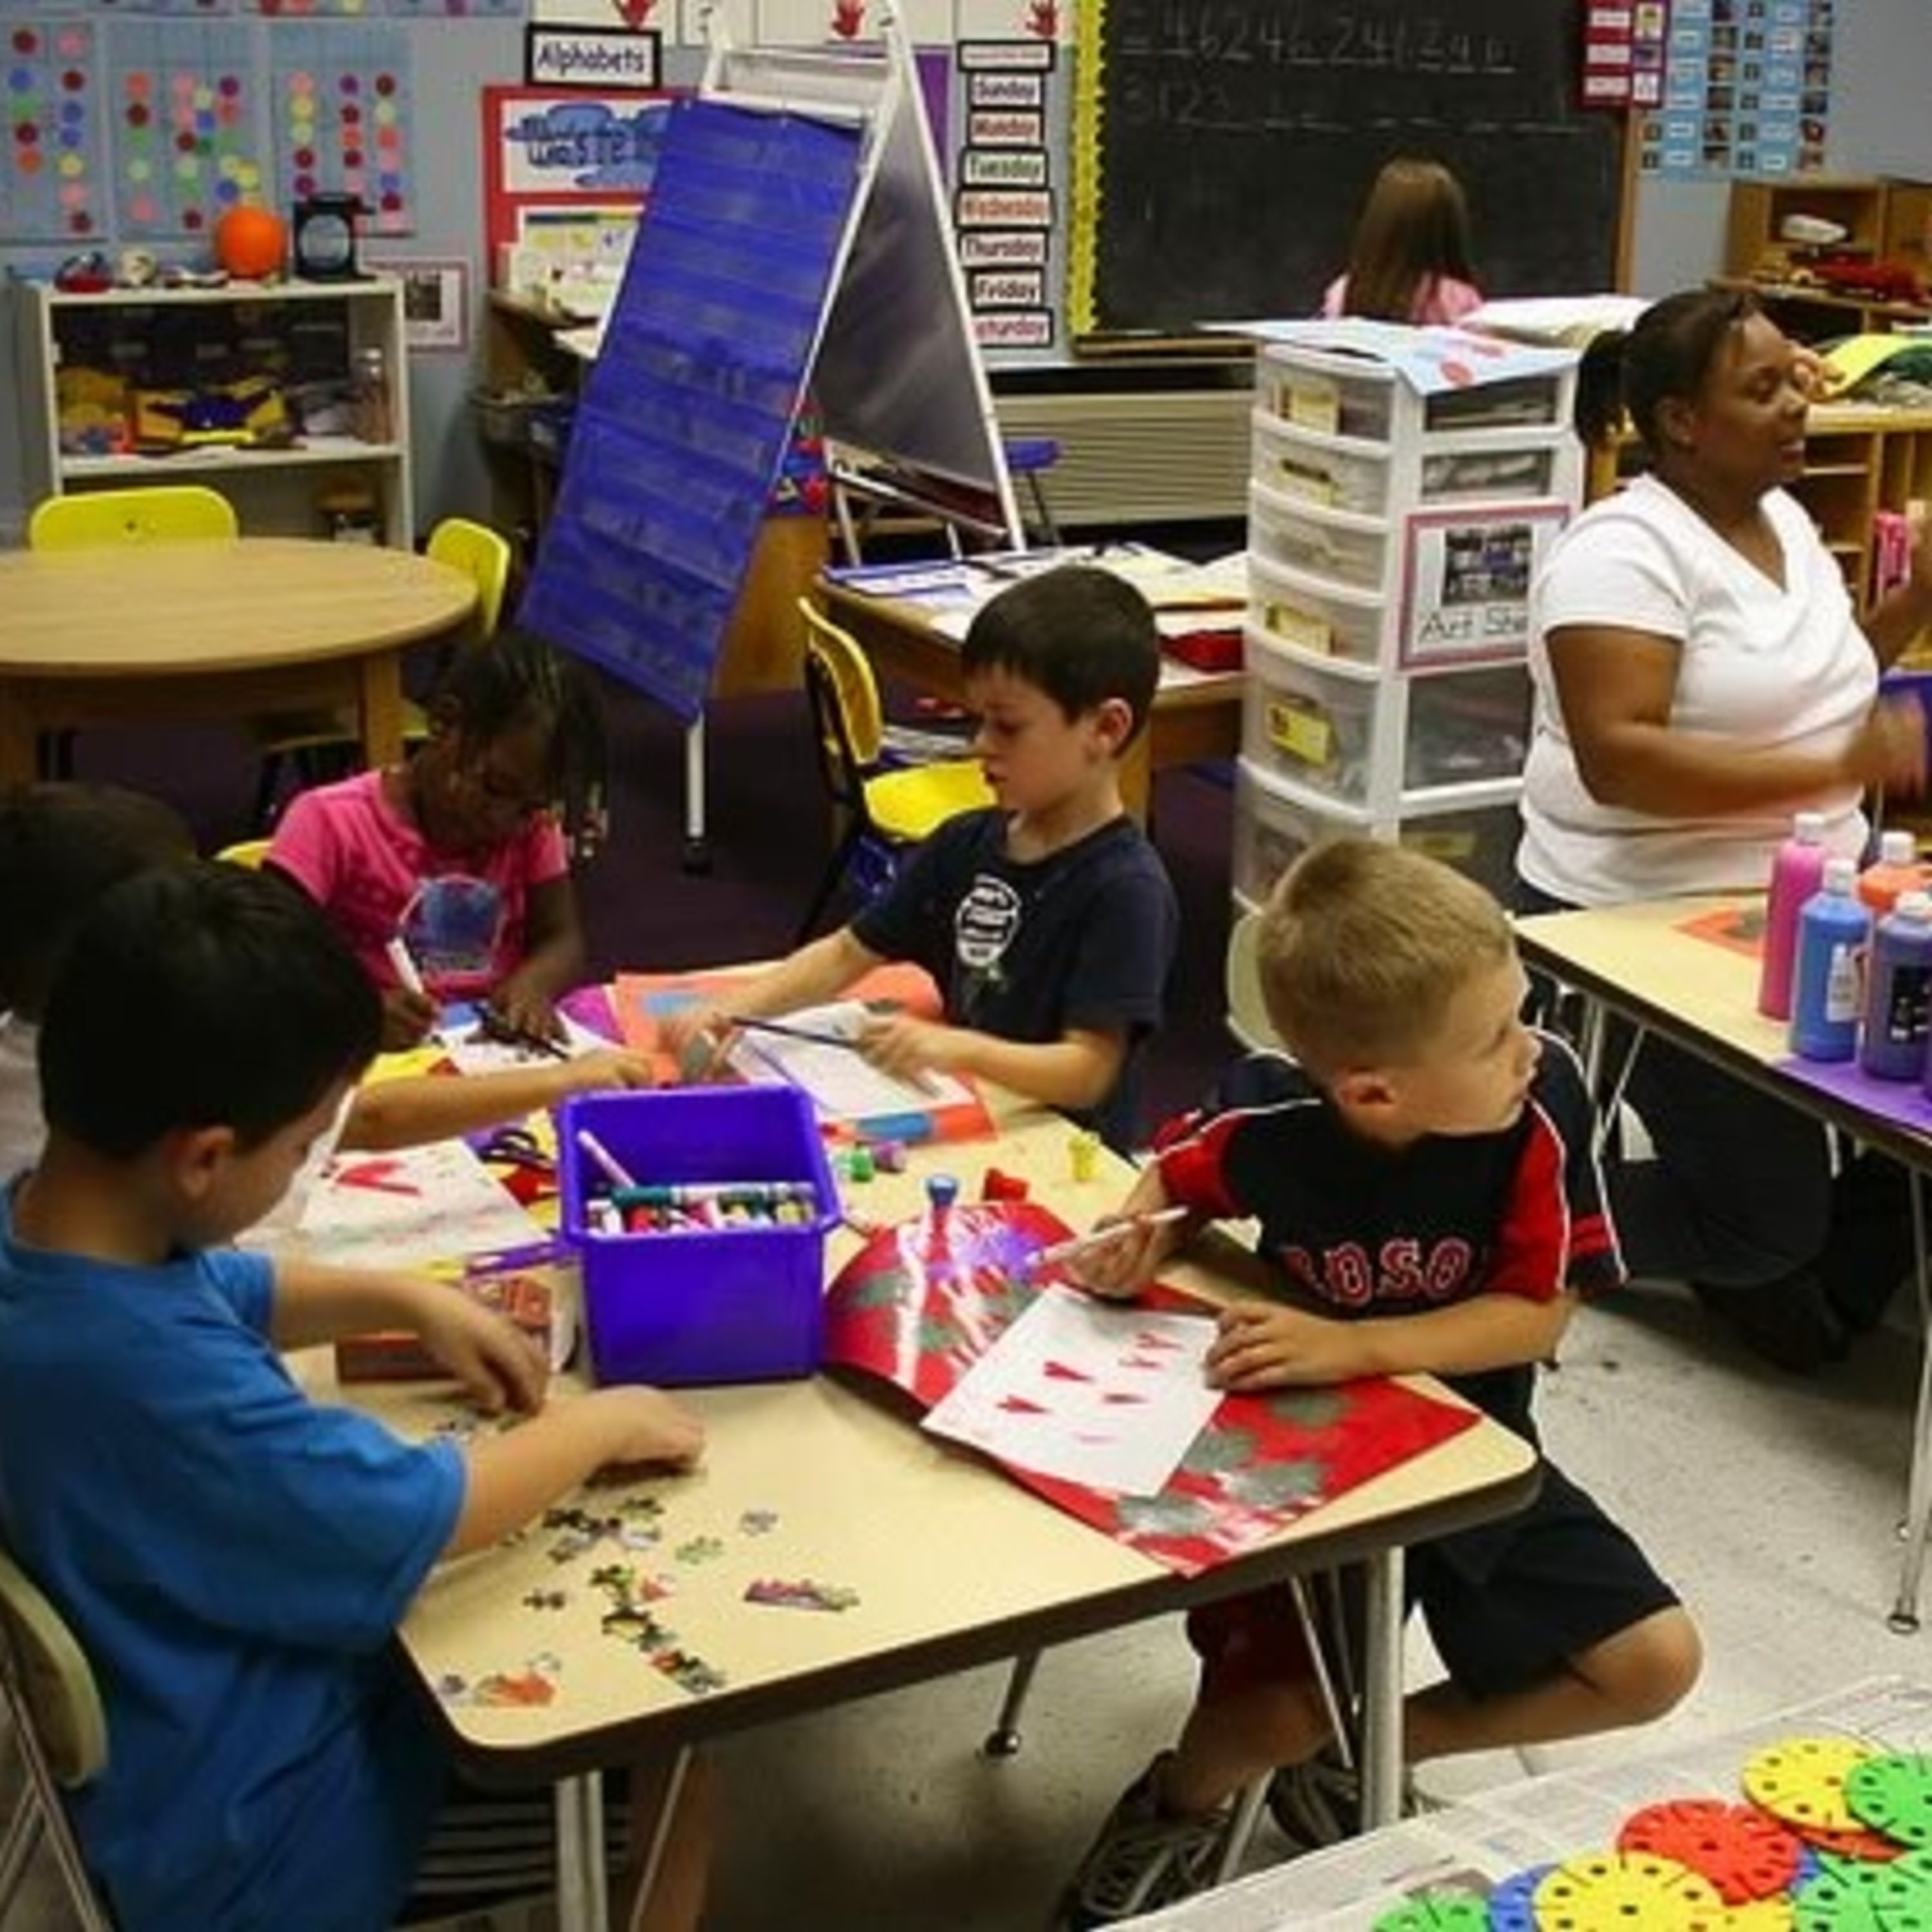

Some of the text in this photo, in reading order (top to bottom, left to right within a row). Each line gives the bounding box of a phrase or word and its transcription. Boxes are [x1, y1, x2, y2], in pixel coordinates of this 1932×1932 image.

[537, 40, 645, 77] Alphabets
[975, 78, 1036, 102] Sunday
[969, 156, 1041, 183] Tuesday
[965, 195, 1048, 223] Wednesday
[966, 236, 1041, 260] Thursday
[979, 278, 1036, 304] Friday
[974, 316, 1046, 343] aturday
[1417, 611, 1473, 643] Art
